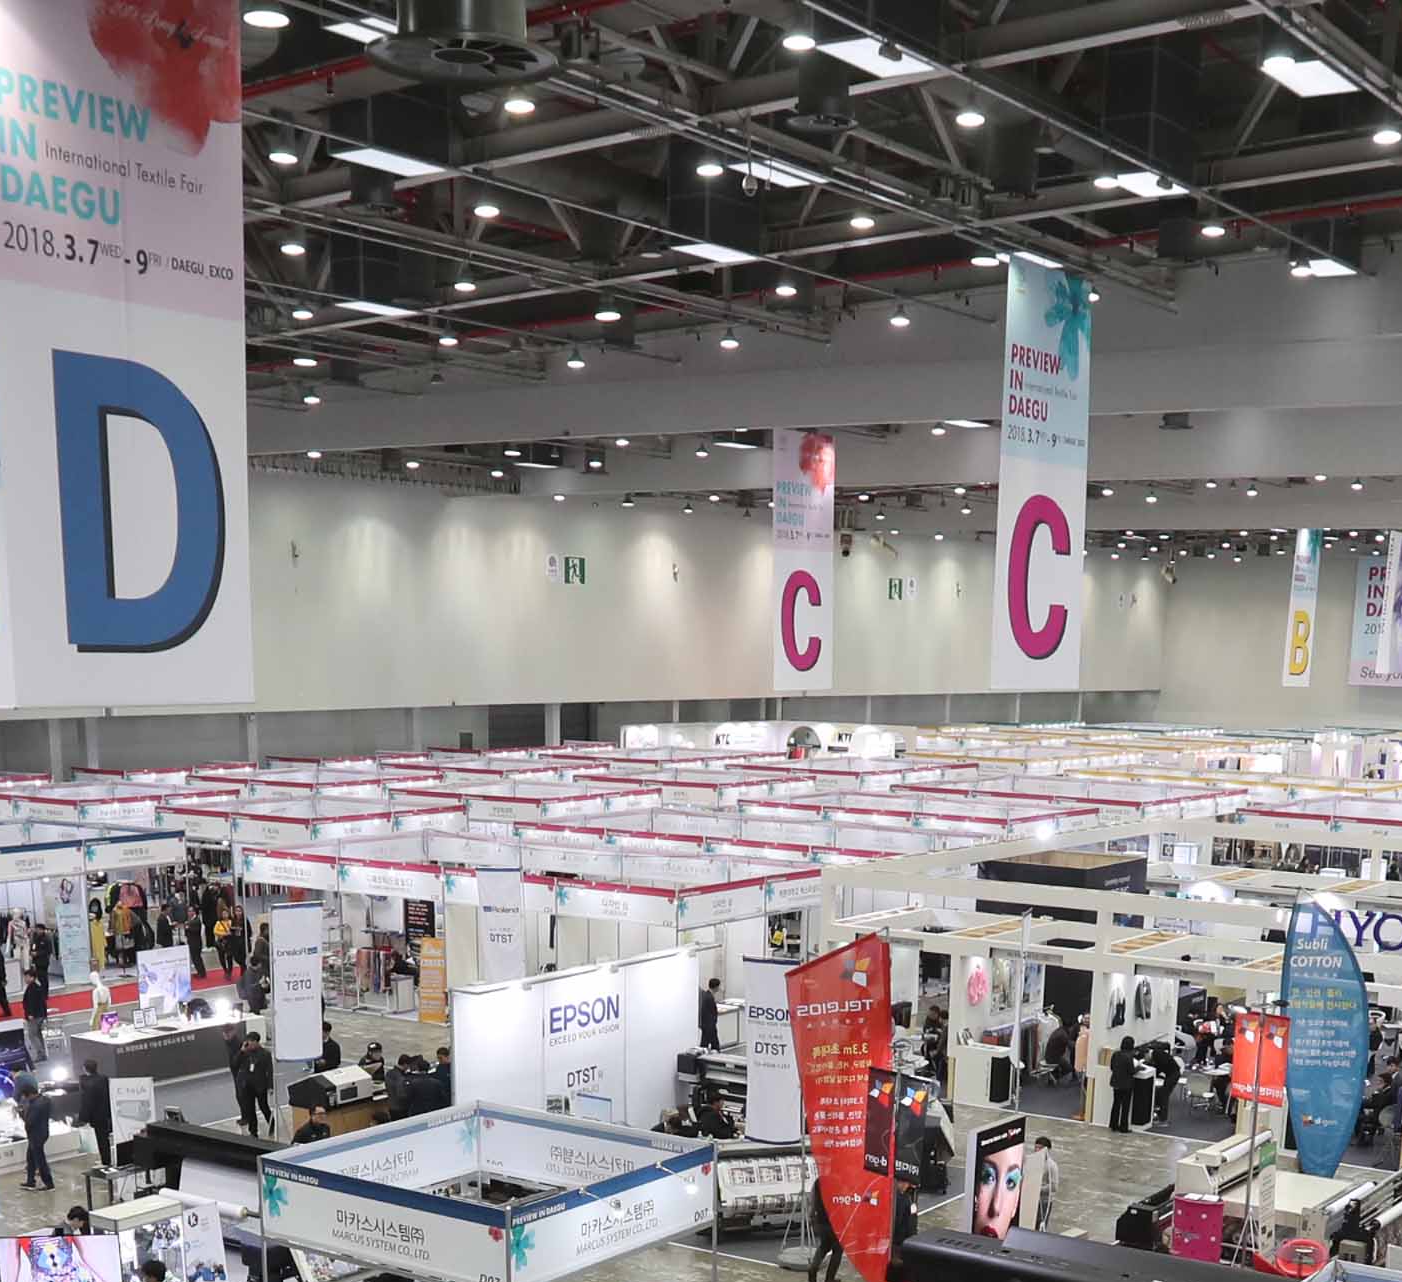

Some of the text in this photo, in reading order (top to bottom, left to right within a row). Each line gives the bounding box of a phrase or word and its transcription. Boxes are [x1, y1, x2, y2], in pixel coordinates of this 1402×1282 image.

[46, 140, 130, 177] International
[136, 163, 176, 189] Textile
[0, 163, 121, 226] DAEGU
[210, 262, 234, 281] EXCO
[1011, 343, 1062, 376] PREVIEW
[1009, 369, 1024, 391] IN
[1008, 395, 1048, 422] DAEGU
[52, 348, 225, 653] D
[1007, 494, 1071, 660] C
[781, 569, 822, 672] C
[1289, 611, 1310, 676] B
[1296, 938, 1329, 951] Subli
[1290, 955, 1343, 969] COTTON
[549, 994, 620, 1034] EPSON
[549, 1033, 577, 1047] EXCEED
[579, 1029, 596, 1040] YOUR
[754, 1041, 787, 1057] DTST
[567, 1066, 597, 1087] DTST
[511, 1210, 538, 1226] PREVIEW
[332, 1228, 365, 1246] MARCUS
[365, 1235, 397, 1254] SYSTEM
[576, 1235, 605, 1256] MARCUS
[605, 1226, 633, 1246] SYSTEM
